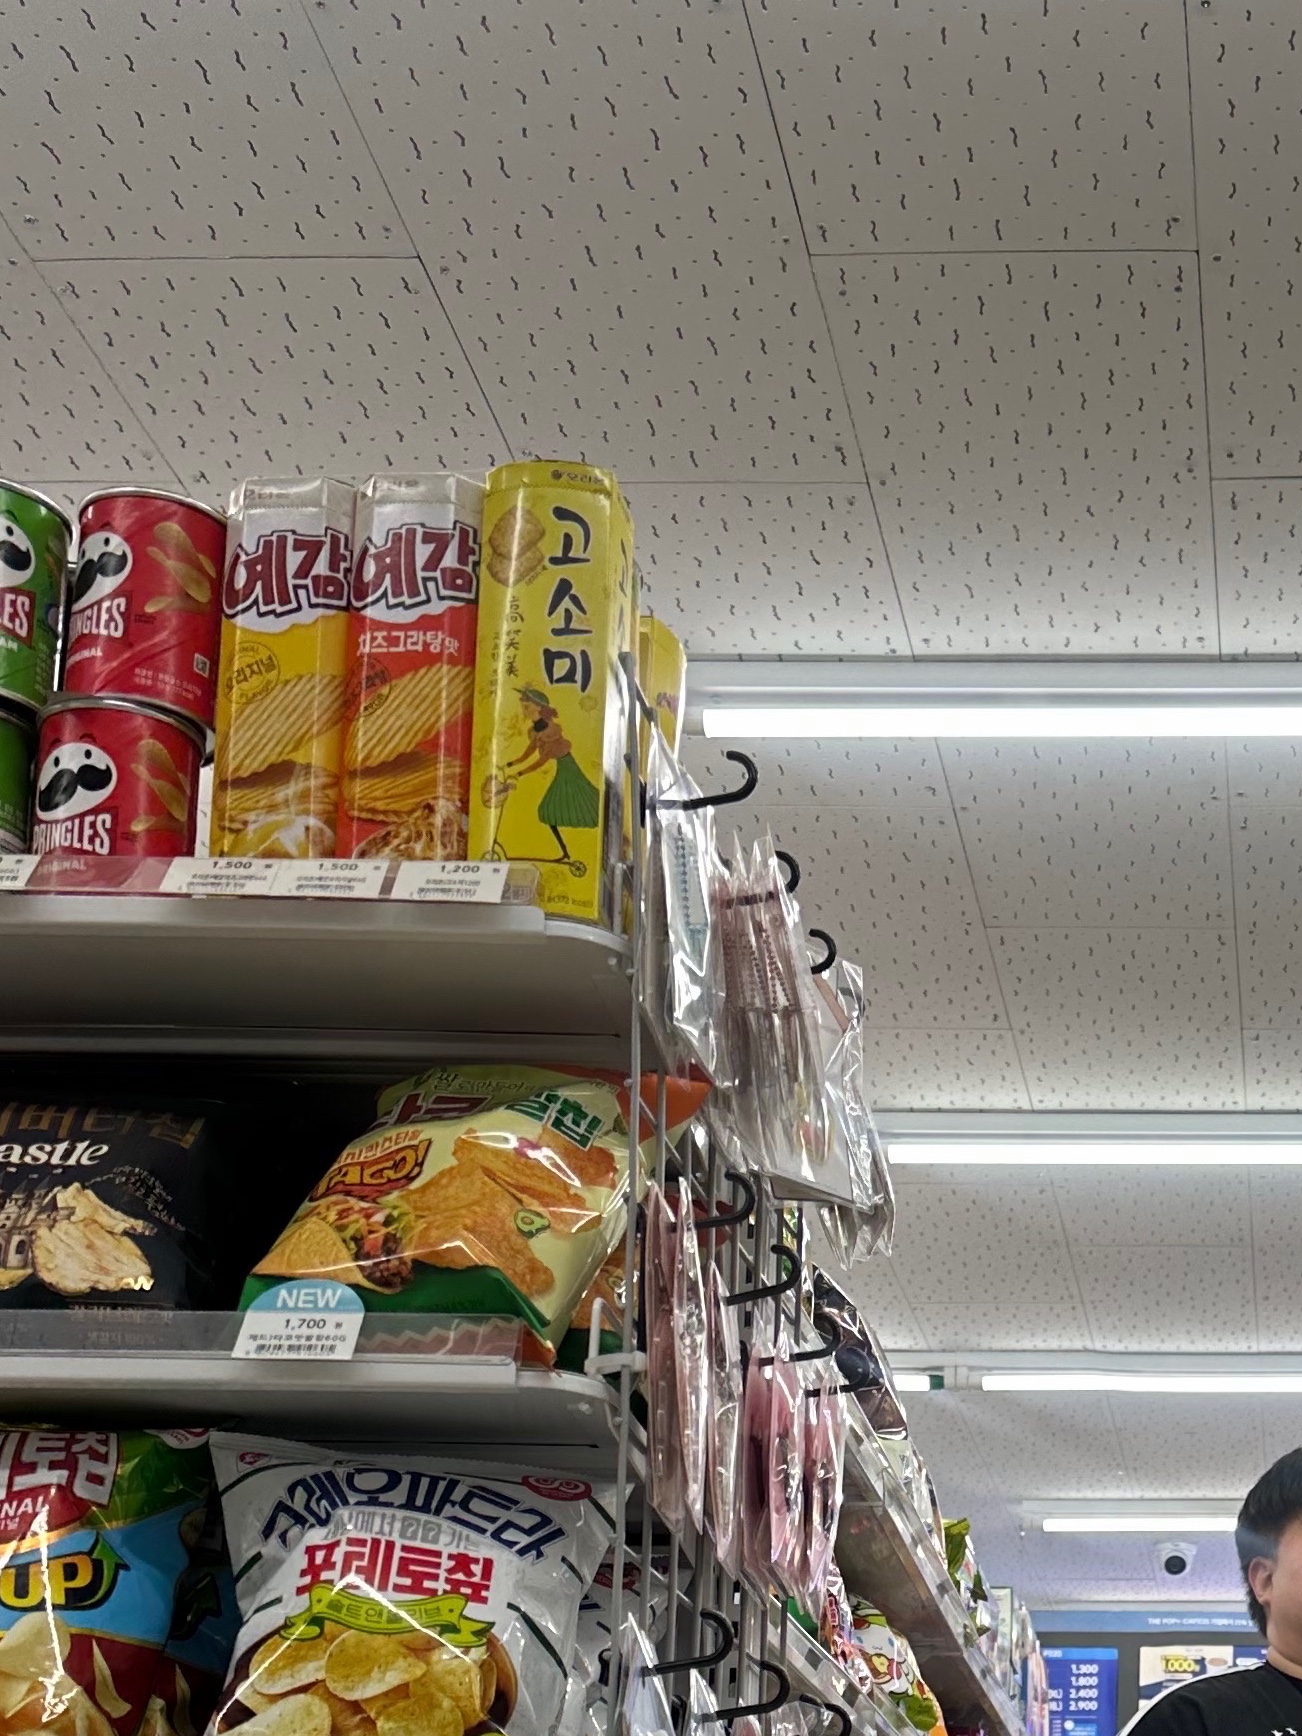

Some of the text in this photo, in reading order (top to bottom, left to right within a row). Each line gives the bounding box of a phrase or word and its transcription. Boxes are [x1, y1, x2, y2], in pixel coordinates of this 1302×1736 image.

[224, 529, 351, 615] 예감
[351, 524, 479, 609] 예감
[546, 504, 594, 693] 고소미
[33, 813, 112, 857] PRINGLES
[276, 1288, 342, 1309] NEW
[284, 1318, 327, 1331] 1,700
[0, 1554, 94, 1609] UP
